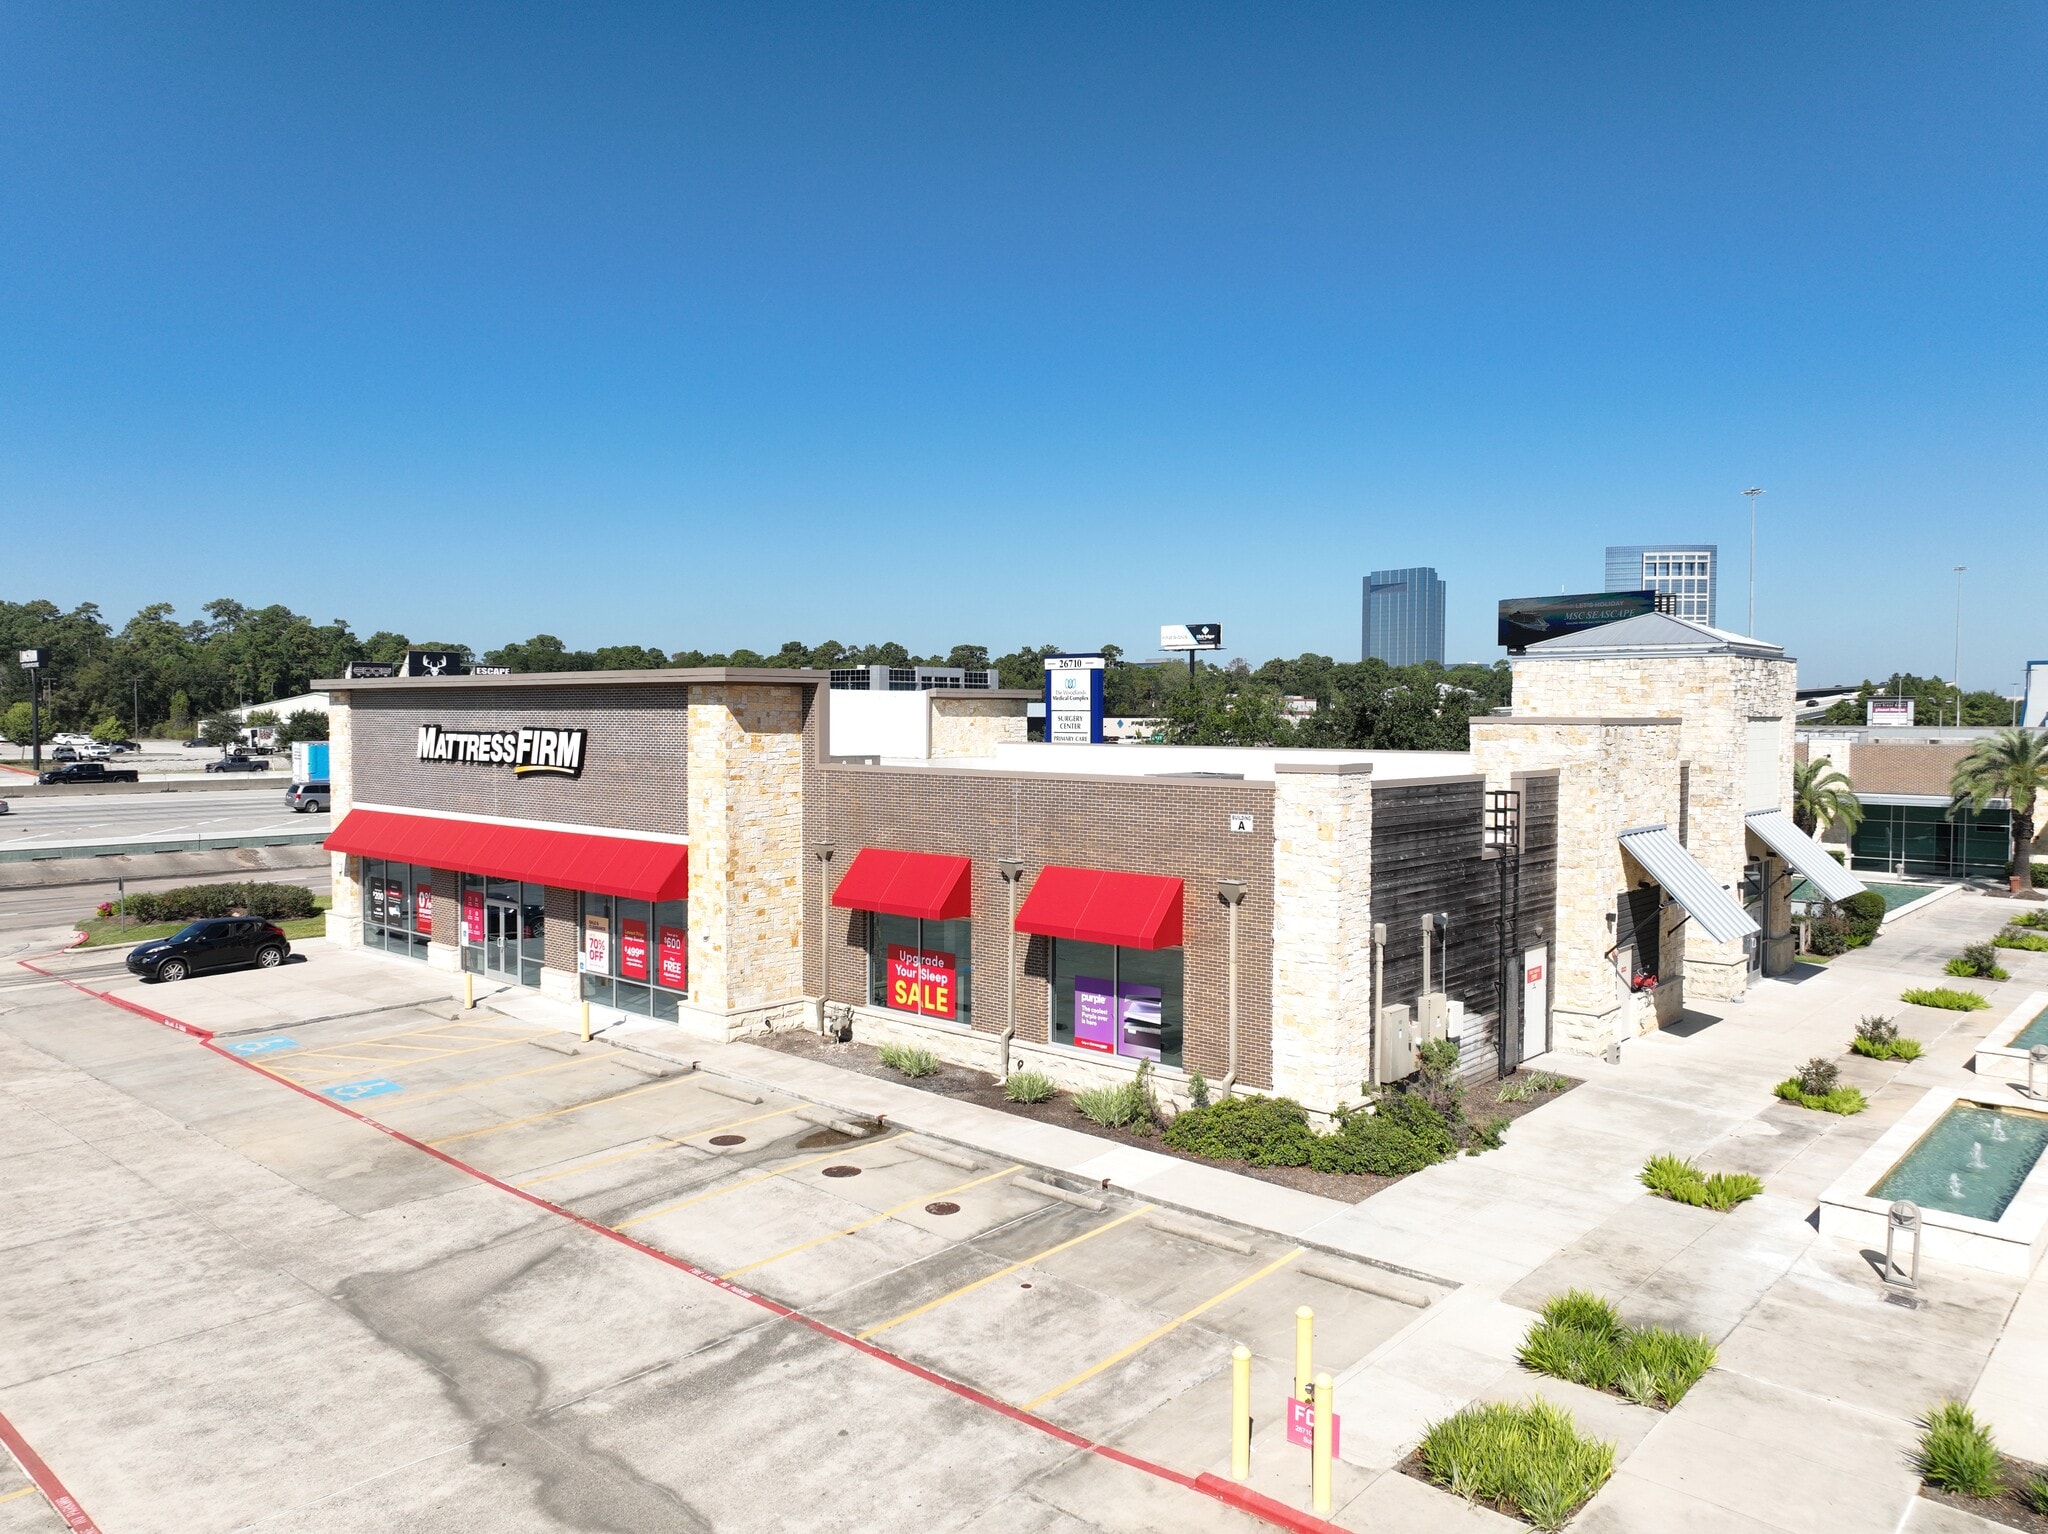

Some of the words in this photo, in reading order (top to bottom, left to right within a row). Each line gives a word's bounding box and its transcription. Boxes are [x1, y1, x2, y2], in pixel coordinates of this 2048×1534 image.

[1564, 612, 1584, 620] MSC
[1586, 609, 1636, 619] SEASCAPE
[1059, 659, 1082, 668] 26710
[476, 667, 511, 676] ESCAPE
[1060, 722, 1081, 730] CENTER
[1238, 821, 1246, 830] A
[589, 937, 605, 950] 70%
[664, 936, 681, 949] $600
[589, 949, 604, 961] OFF
[899, 950, 945, 967] Upgrade
[663, 959, 682, 974] FREE
[895, 964, 917, 978] Your
[921, 968, 948, 987] Sleep
[895, 979, 948, 1013] SALE
[1081, 993, 1106, 1005] purple
[1082, 1004, 1091, 1012] The
